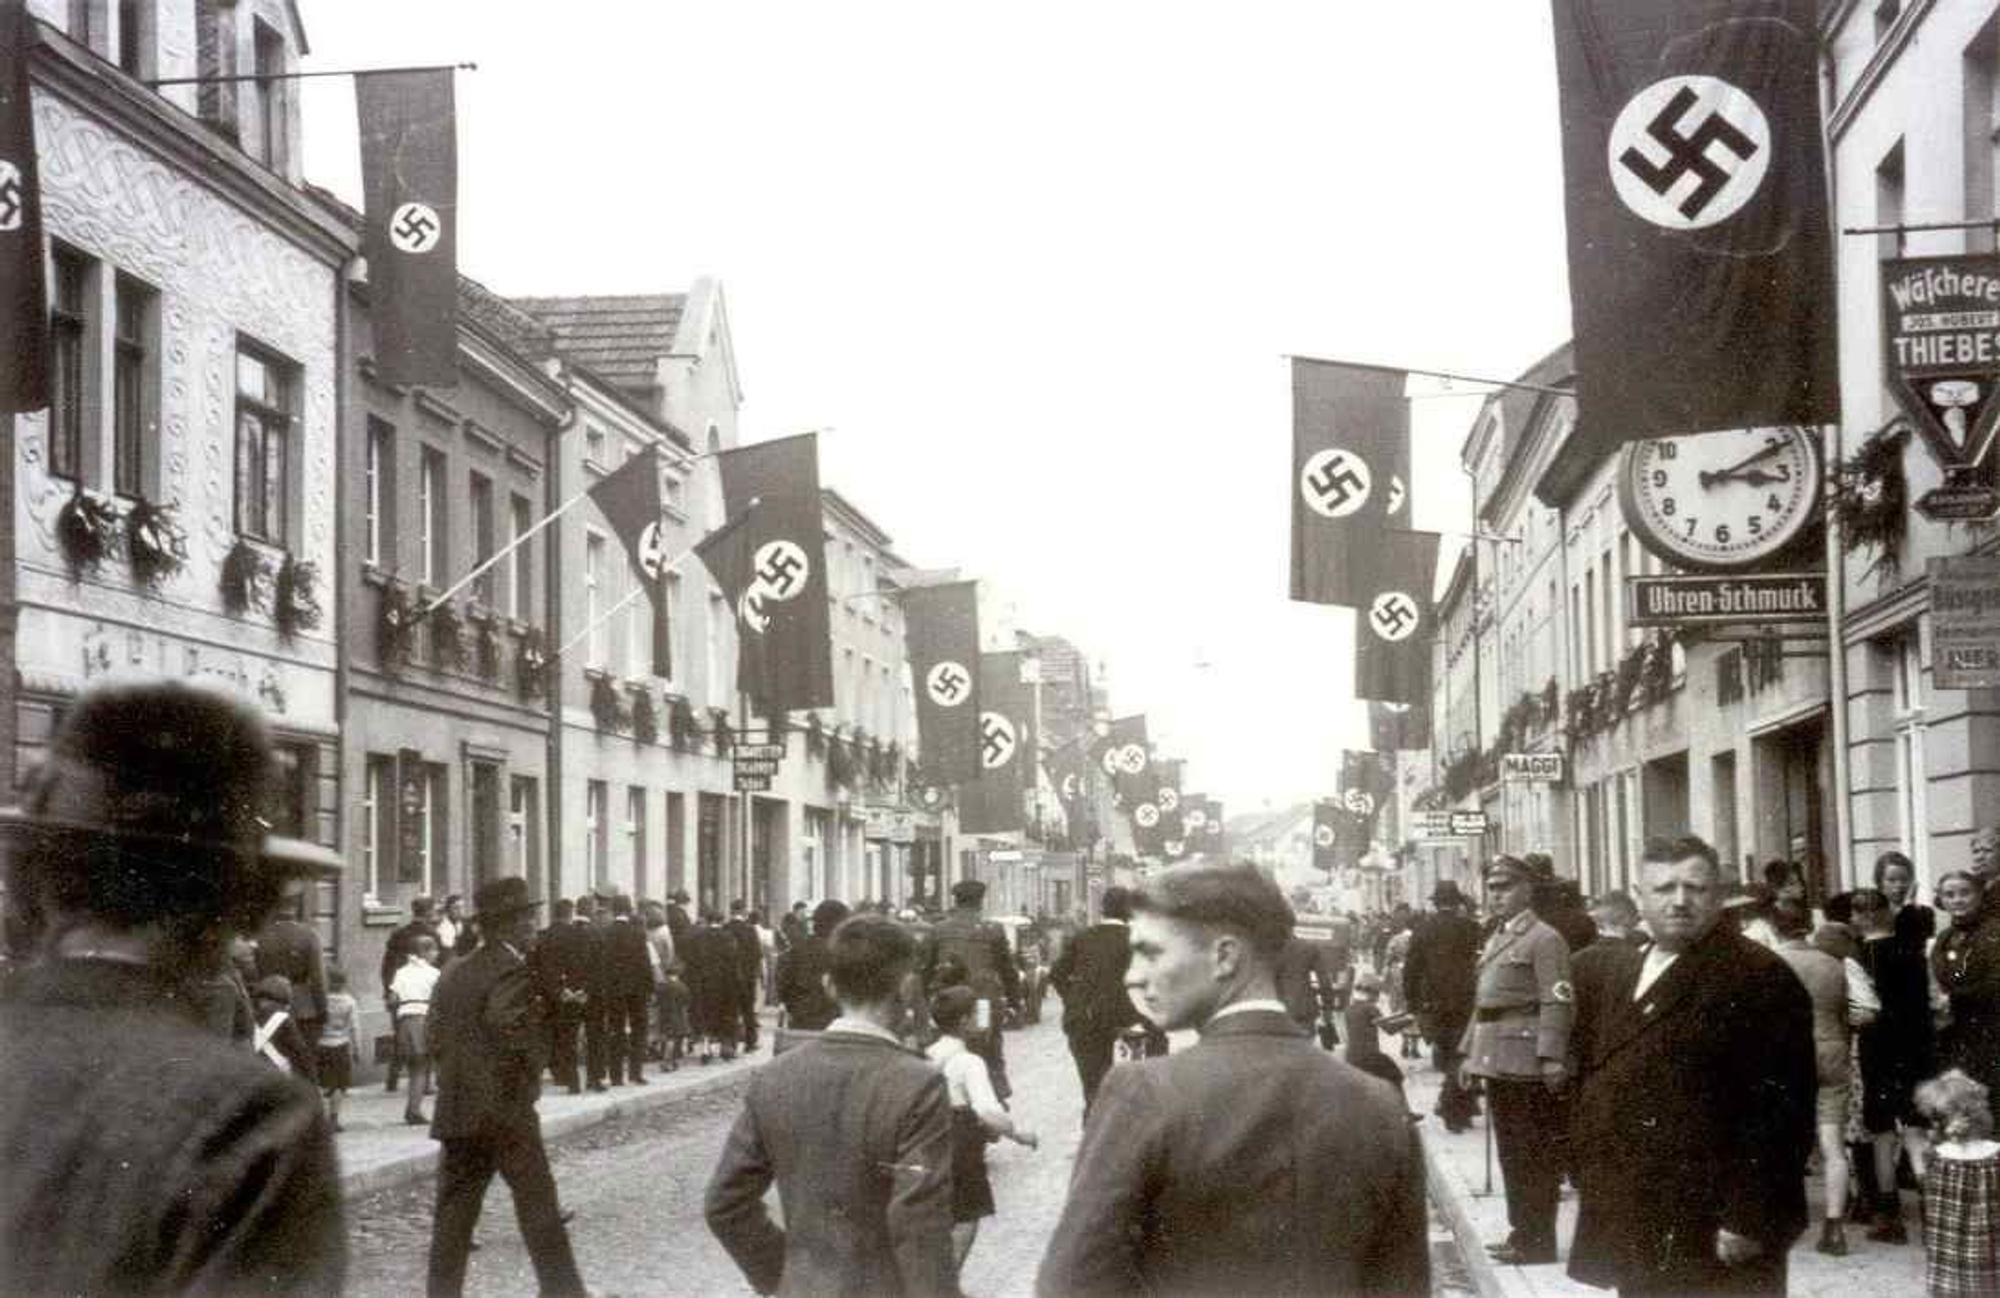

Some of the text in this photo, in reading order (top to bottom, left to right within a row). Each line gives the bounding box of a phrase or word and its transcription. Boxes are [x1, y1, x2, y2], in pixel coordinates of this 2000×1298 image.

[1658, 442, 1677, 460] 10
[1653, 470, 1668, 488] 9
[1662, 498, 1676, 516] 8
[1767, 494, 1781, 513] 4
[1686, 518, 1698, 537] 7
[1715, 525, 1730, 543] 6
[1748, 516, 1761, 534] 5
[1649, 583, 1817, 614] Uhren-Schmuck
[1506, 756, 1558, 774] MAGGI
